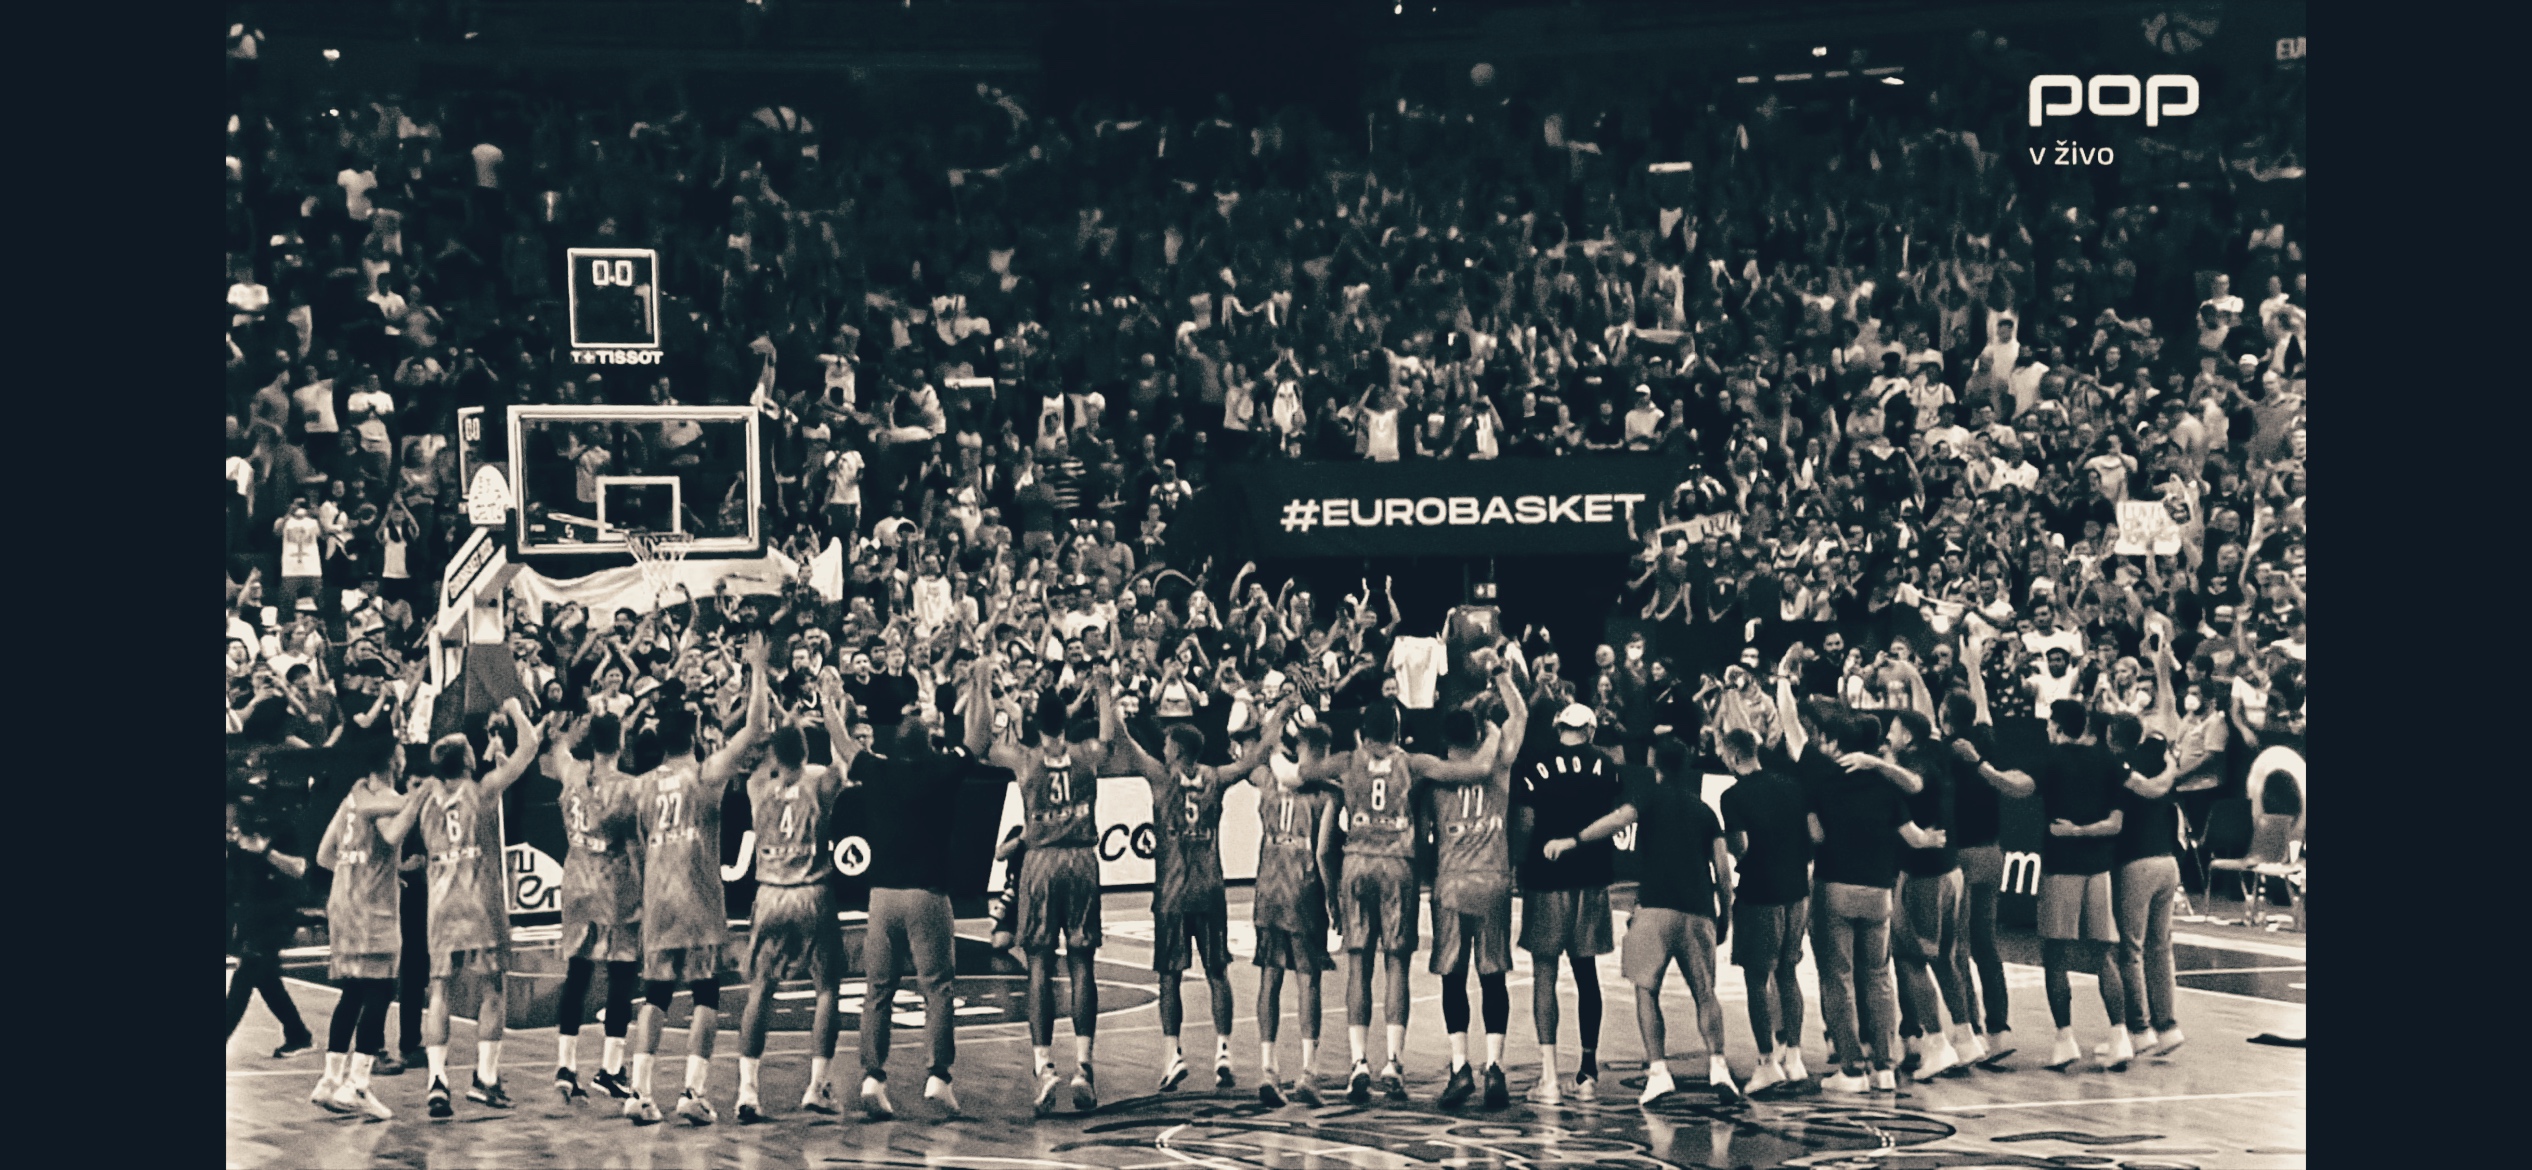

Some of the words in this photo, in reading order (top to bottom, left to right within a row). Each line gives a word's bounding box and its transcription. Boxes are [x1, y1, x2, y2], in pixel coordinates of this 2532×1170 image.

[592, 260, 632, 287] 0.0
[1280, 494, 1646, 533] #EUROBASKET
[1050, 772, 1070, 804] 31
[1372, 778, 1386, 811] 8
[656, 792, 682, 829] 27
[780, 805, 793, 839] 4
[1185, 792, 1199, 824] 5
[446, 809, 462, 843] 6
